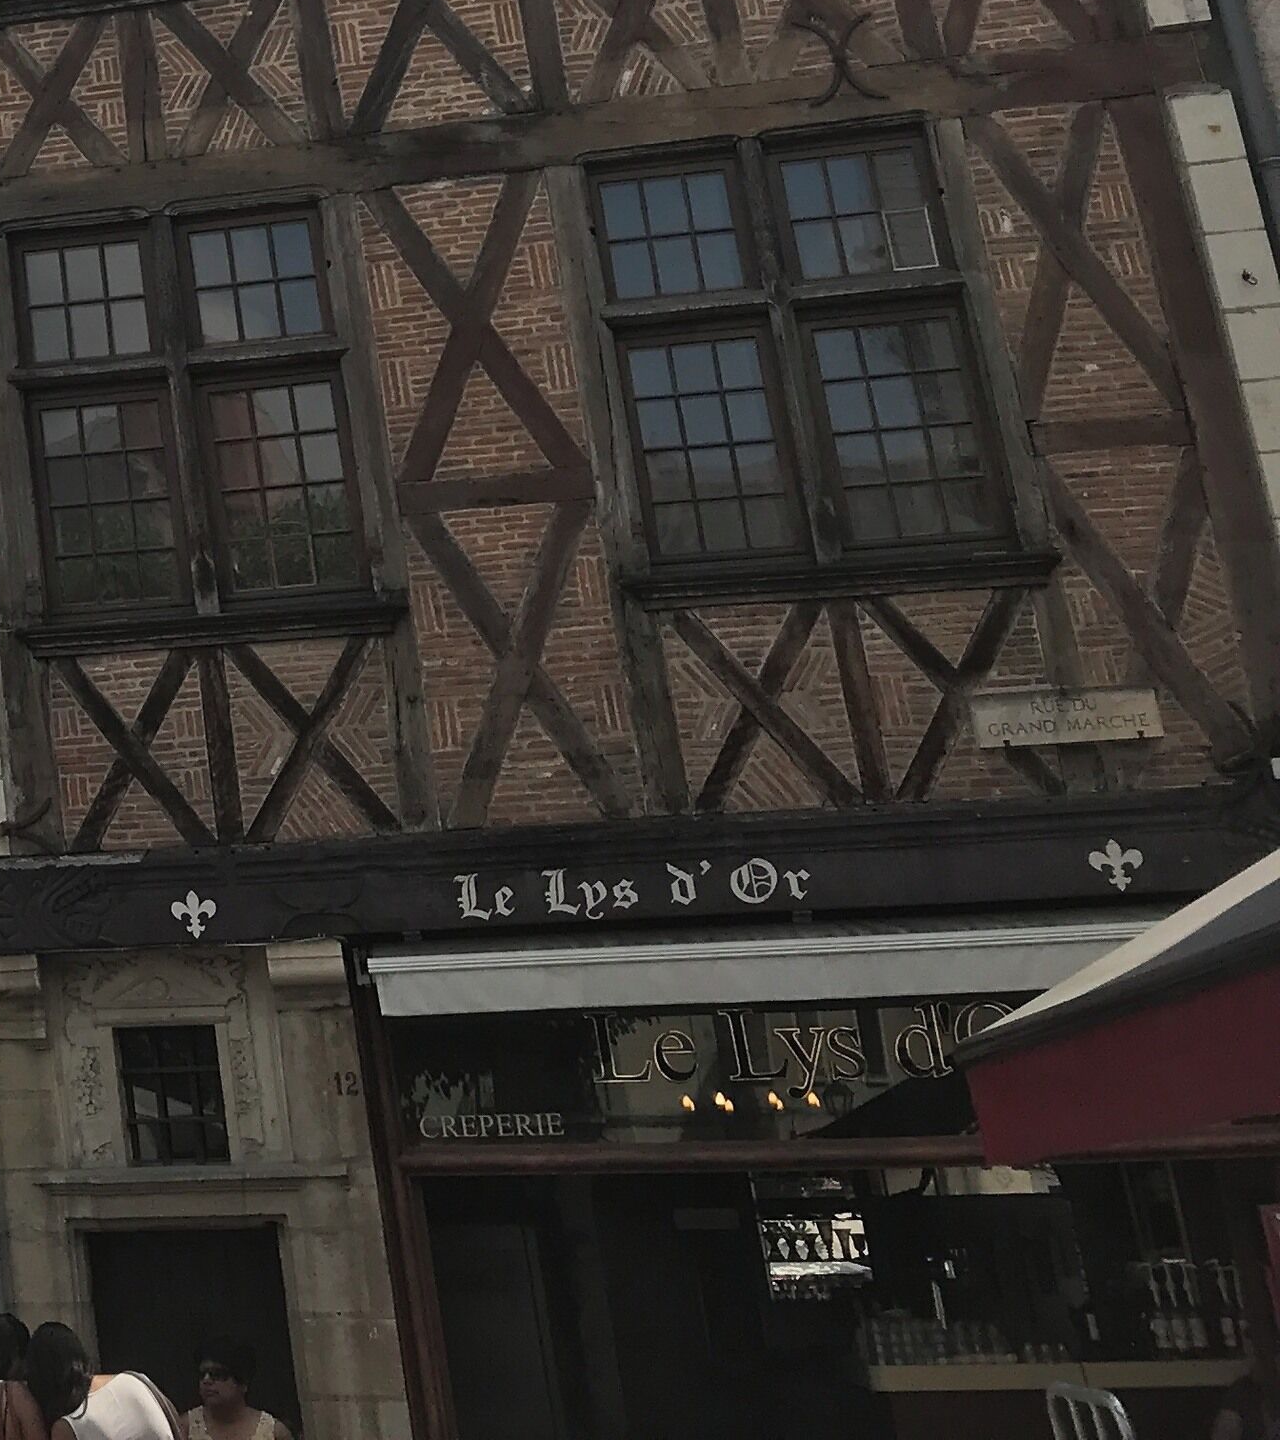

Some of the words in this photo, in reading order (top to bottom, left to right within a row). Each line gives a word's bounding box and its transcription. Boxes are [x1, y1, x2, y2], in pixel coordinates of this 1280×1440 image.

[1030, 698, 1064, 715] RUE
[1072, 697, 1098, 713] DU
[987, 718, 1057, 738] GRAND
[452, 872, 515, 921] Le
[541, 867, 639, 920] Lys
[583, 1009, 699, 1084] Le
[717, 1007, 865, 1099] Lys
[329, 1071, 359, 1097] 12
[419, 1112, 565, 1140] CREPERIE
